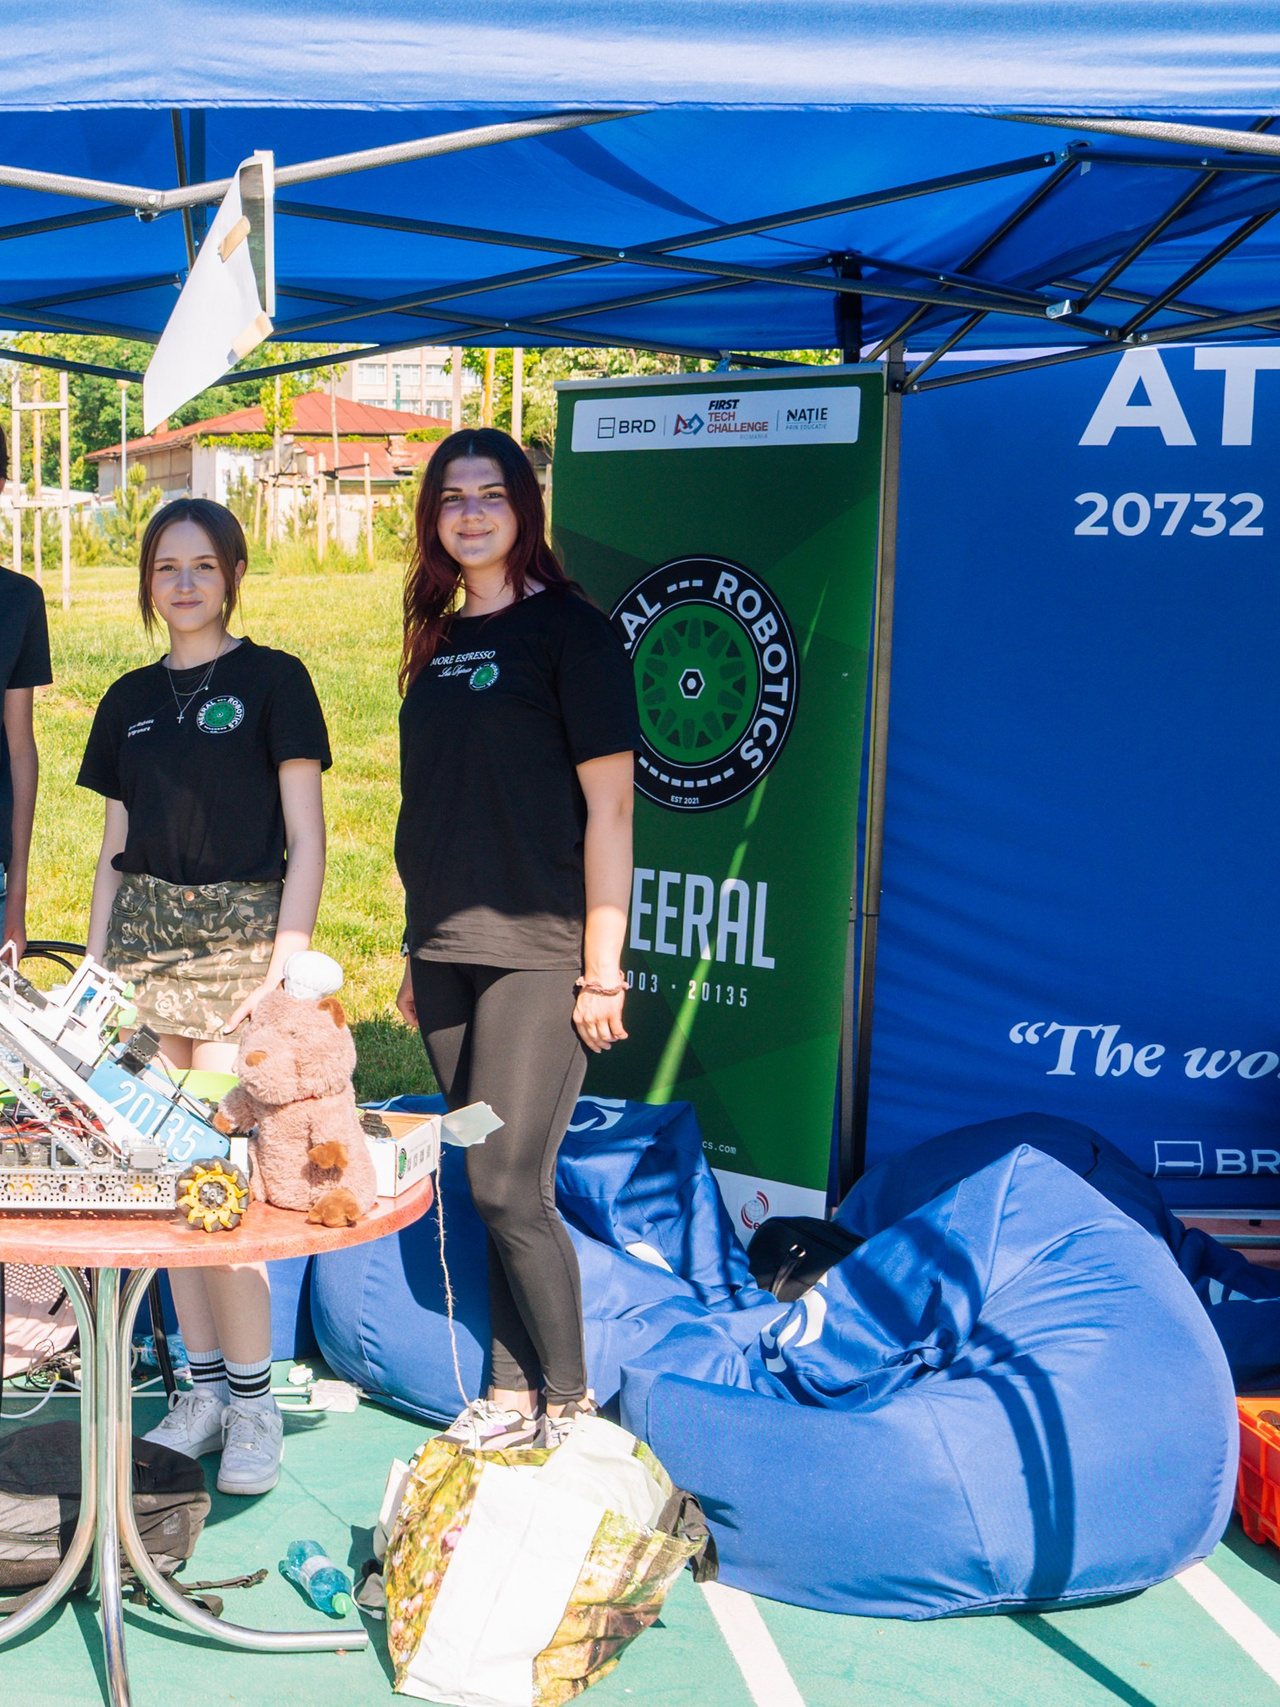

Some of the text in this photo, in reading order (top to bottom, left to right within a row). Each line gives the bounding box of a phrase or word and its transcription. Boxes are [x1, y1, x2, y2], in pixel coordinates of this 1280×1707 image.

[708, 399, 740, 410] FIRST
[619, 419, 656, 434] BRD
[708, 411, 736, 422] TECH
[707, 421, 768, 433] CHALLENGE
[1074, 492, 1264, 536] 20732
[455, 650, 496, 663] ESPRESSO
[620, 571, 789, 769] AL ROBOTICS
[671, 795, 683, 803] EST
[629, 867, 776, 970] EERAL
[626, 970, 748, 1007] 003 20135
[1184, 1047, 1280, 1079] wo
[109, 1080, 206, 1162] 20135
[701, 1140, 737, 1155] cs.com
[1215, 1149, 1280, 1175] BR
